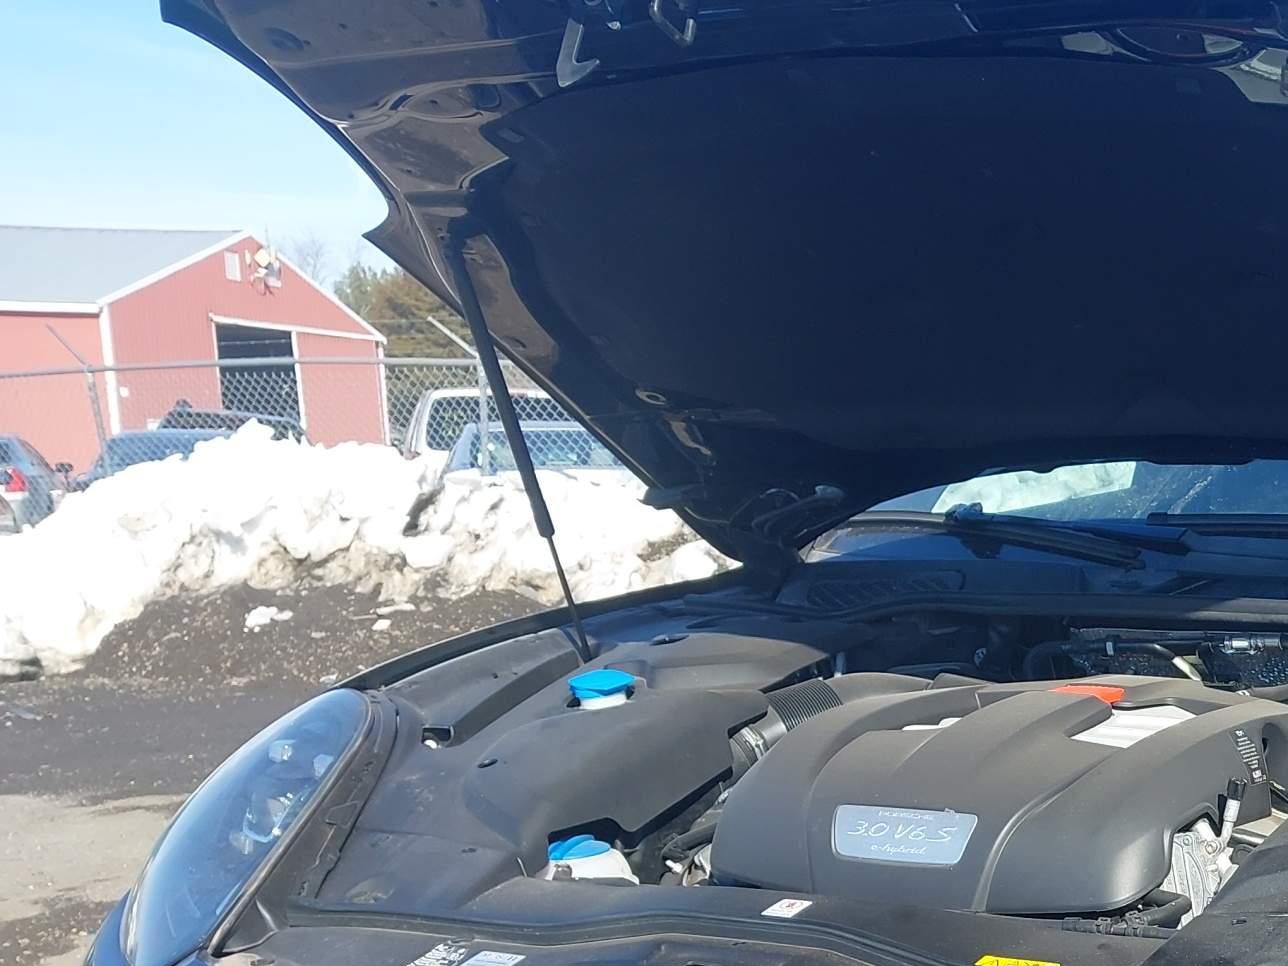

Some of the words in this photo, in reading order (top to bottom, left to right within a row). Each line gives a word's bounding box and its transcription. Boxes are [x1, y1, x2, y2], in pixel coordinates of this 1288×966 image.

[847, 820, 890, 837] 3.0
[894, 823, 925, 841] V6
[926, 826, 958, 843] S
